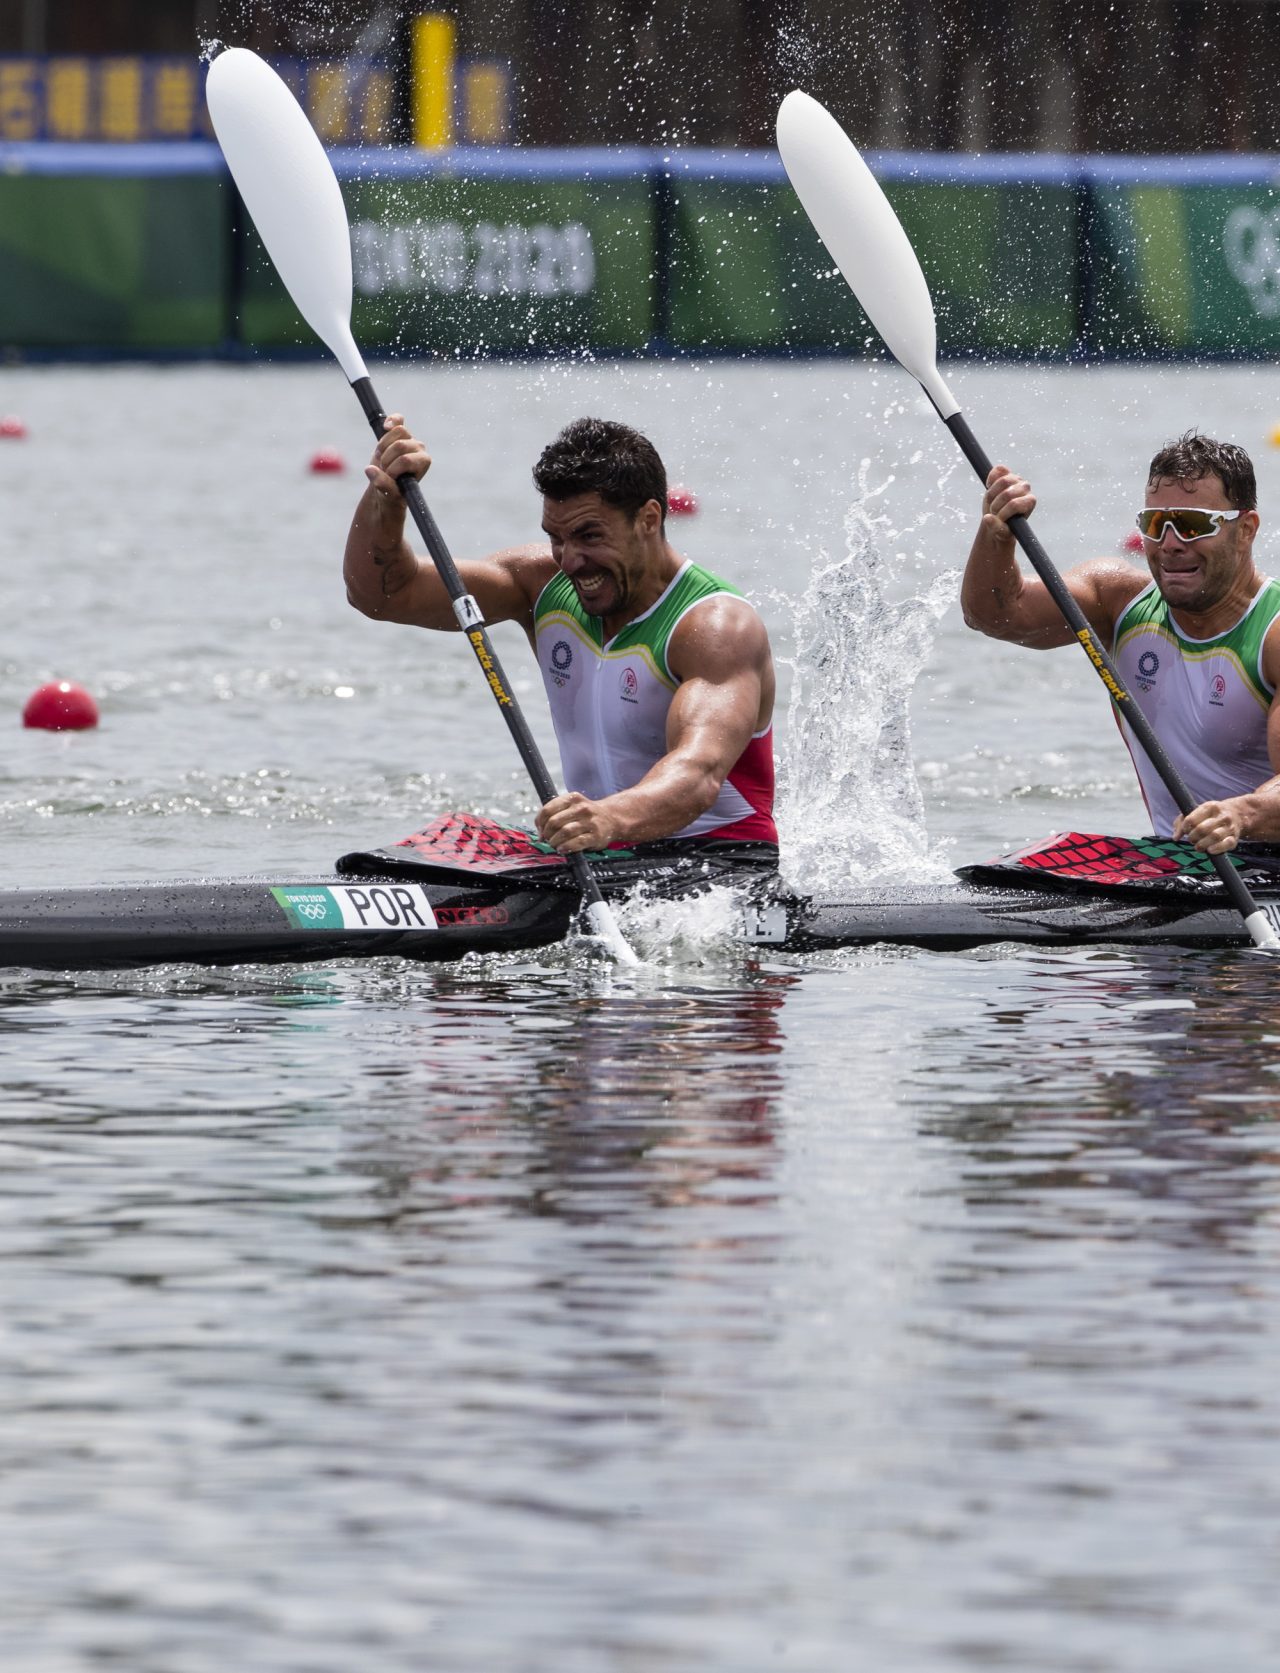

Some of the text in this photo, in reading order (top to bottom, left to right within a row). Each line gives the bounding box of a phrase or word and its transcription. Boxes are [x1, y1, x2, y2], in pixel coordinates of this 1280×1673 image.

[285, 894, 326, 903] TOKYO 2020
[344, 888, 426, 926] POR
